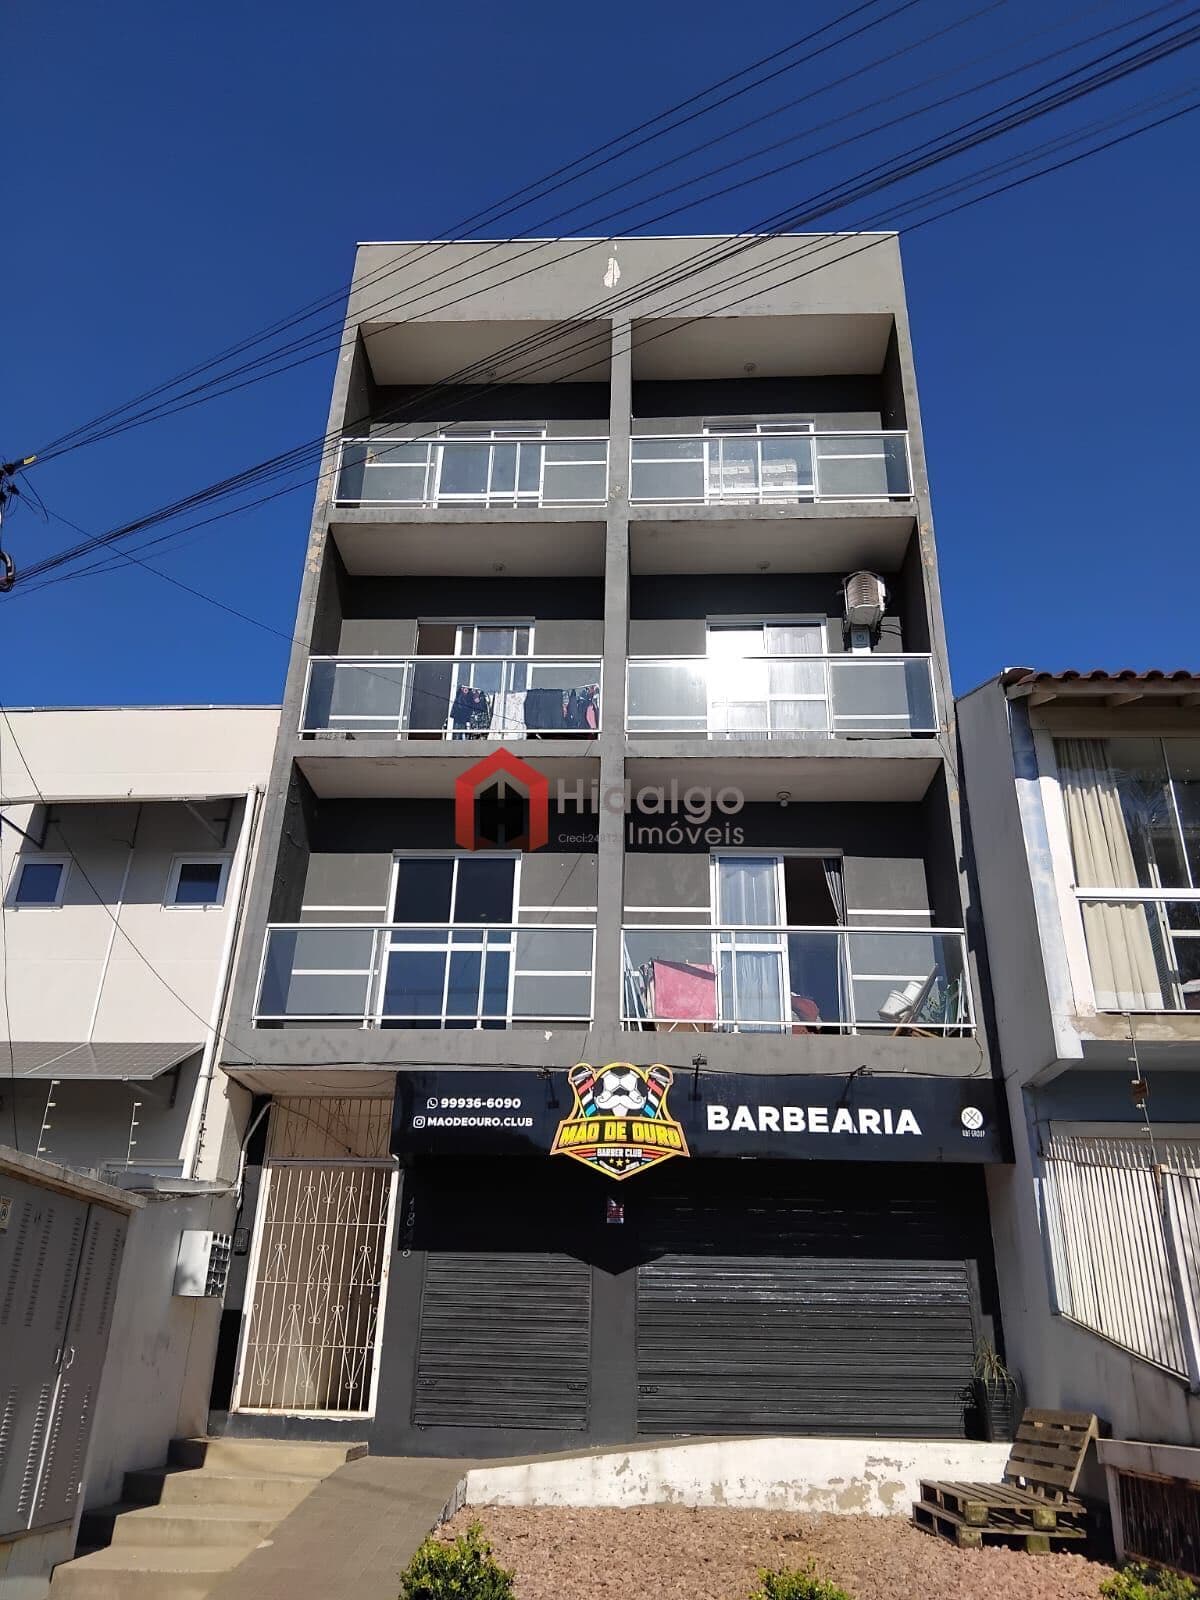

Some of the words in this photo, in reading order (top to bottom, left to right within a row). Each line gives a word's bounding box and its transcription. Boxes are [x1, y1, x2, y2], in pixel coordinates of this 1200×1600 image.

[440, 1097, 522, 1109] 99936-6090
[427, 1116, 534, 1128] MAODEOURO.CLUB
[706, 1105, 923, 1136] BARBEARIA
[604, 1122, 627, 1142] DE
[632, 1121, 682, 1149] OURO
